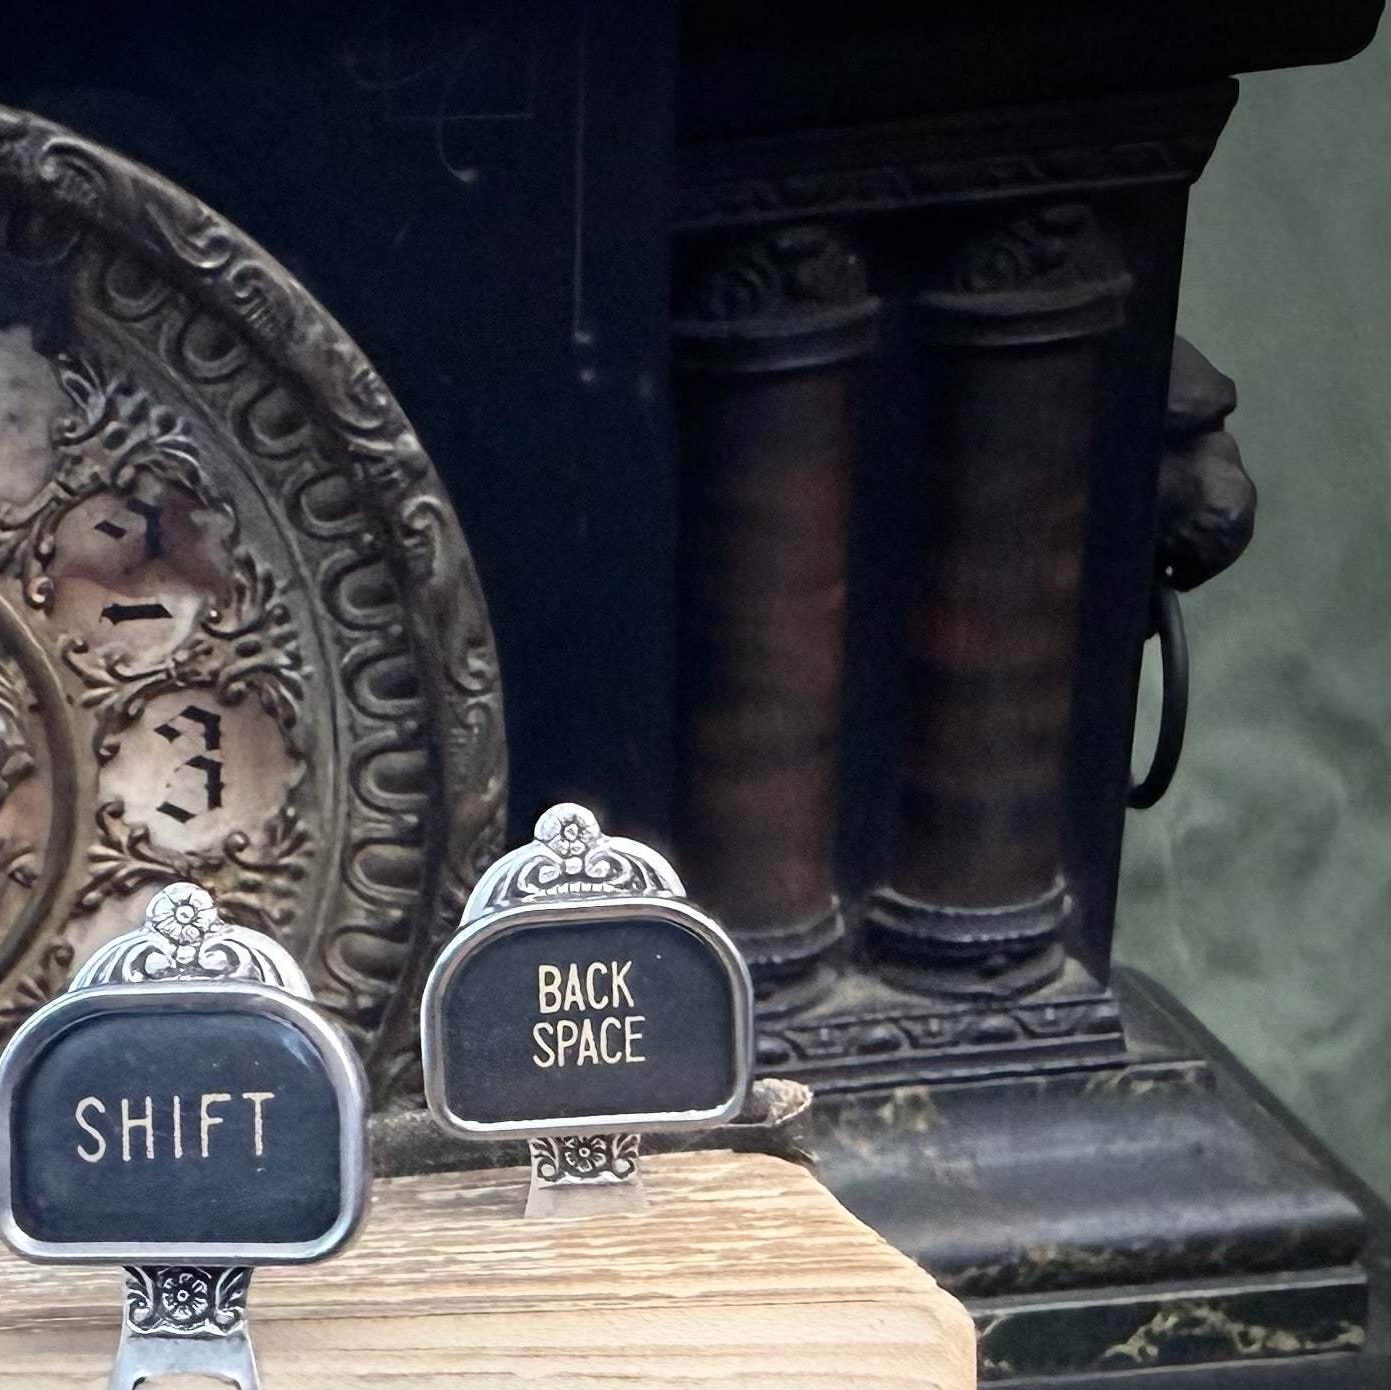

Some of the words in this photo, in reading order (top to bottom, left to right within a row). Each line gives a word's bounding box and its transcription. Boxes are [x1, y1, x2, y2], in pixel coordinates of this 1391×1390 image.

[154, 705, 224, 824] 3
[539, 960, 634, 1014] BACK
[532, 1015, 646, 1068] SPACE
[75, 1092, 274, 1162] SHIFT
